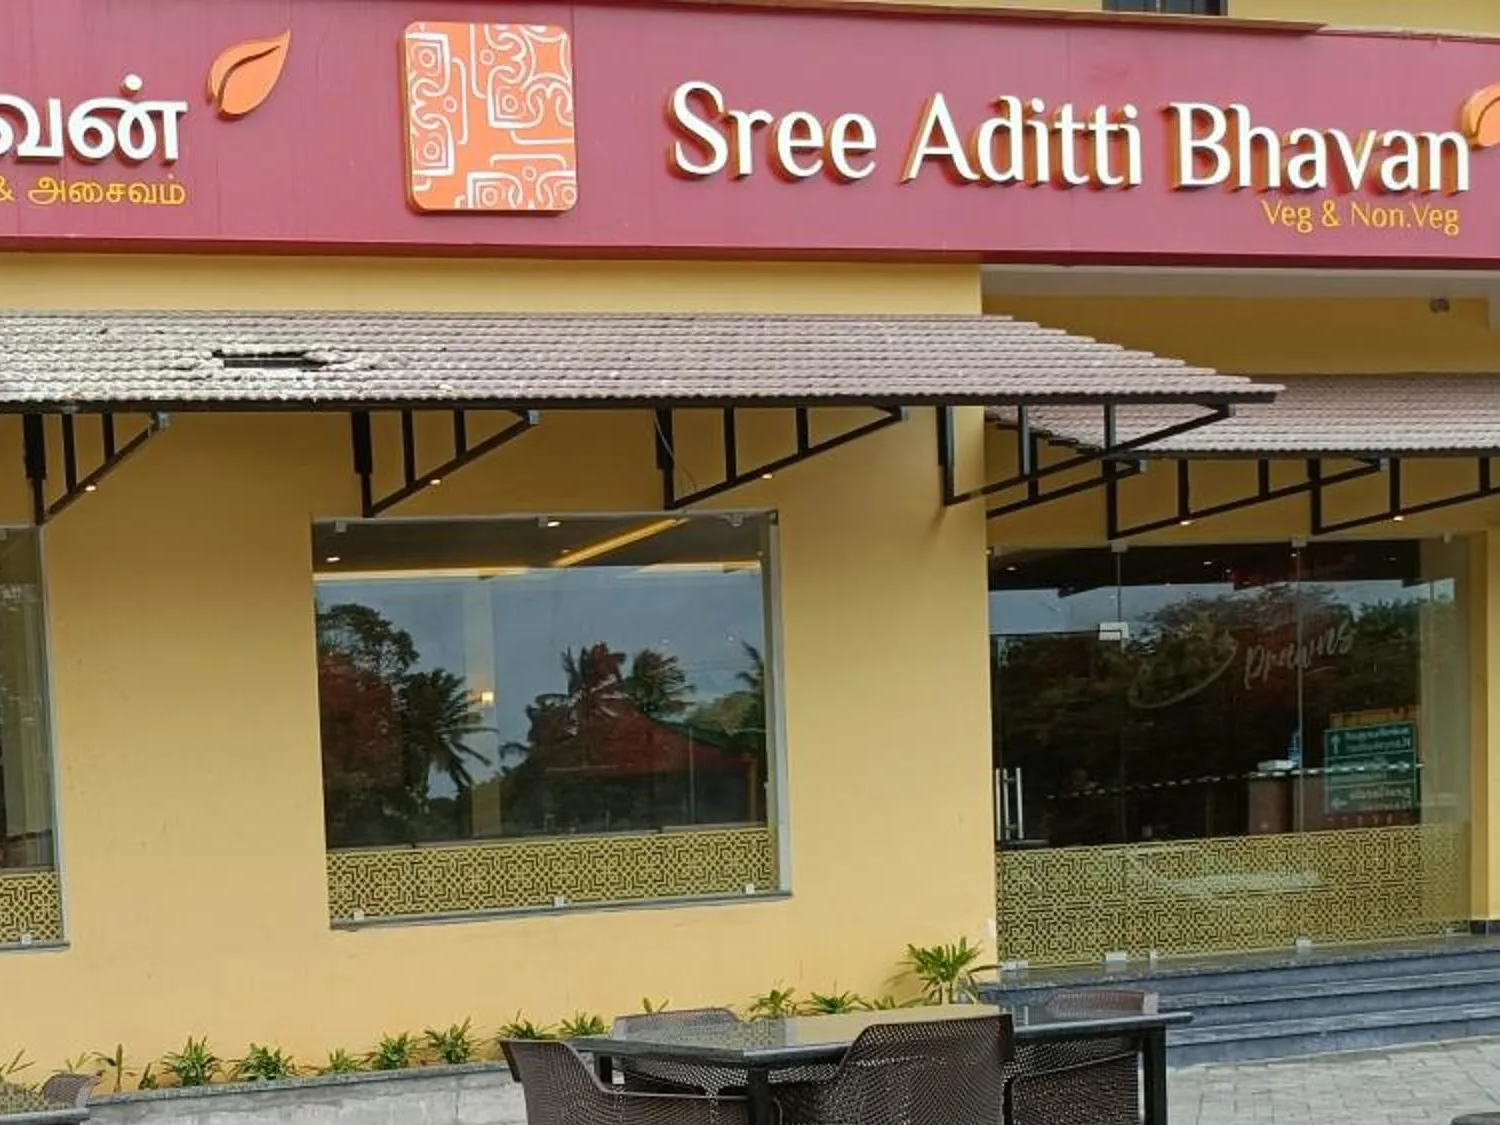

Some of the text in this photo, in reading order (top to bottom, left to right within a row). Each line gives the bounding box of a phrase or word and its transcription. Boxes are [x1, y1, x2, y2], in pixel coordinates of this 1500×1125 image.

[671, 80, 1470, 192] Sree Aditti Bhavan
[27, 173, 187, 205] அசைவம்
[1261, 200, 1314, 233] Veg
[1321, 199, 1342, 227] &
